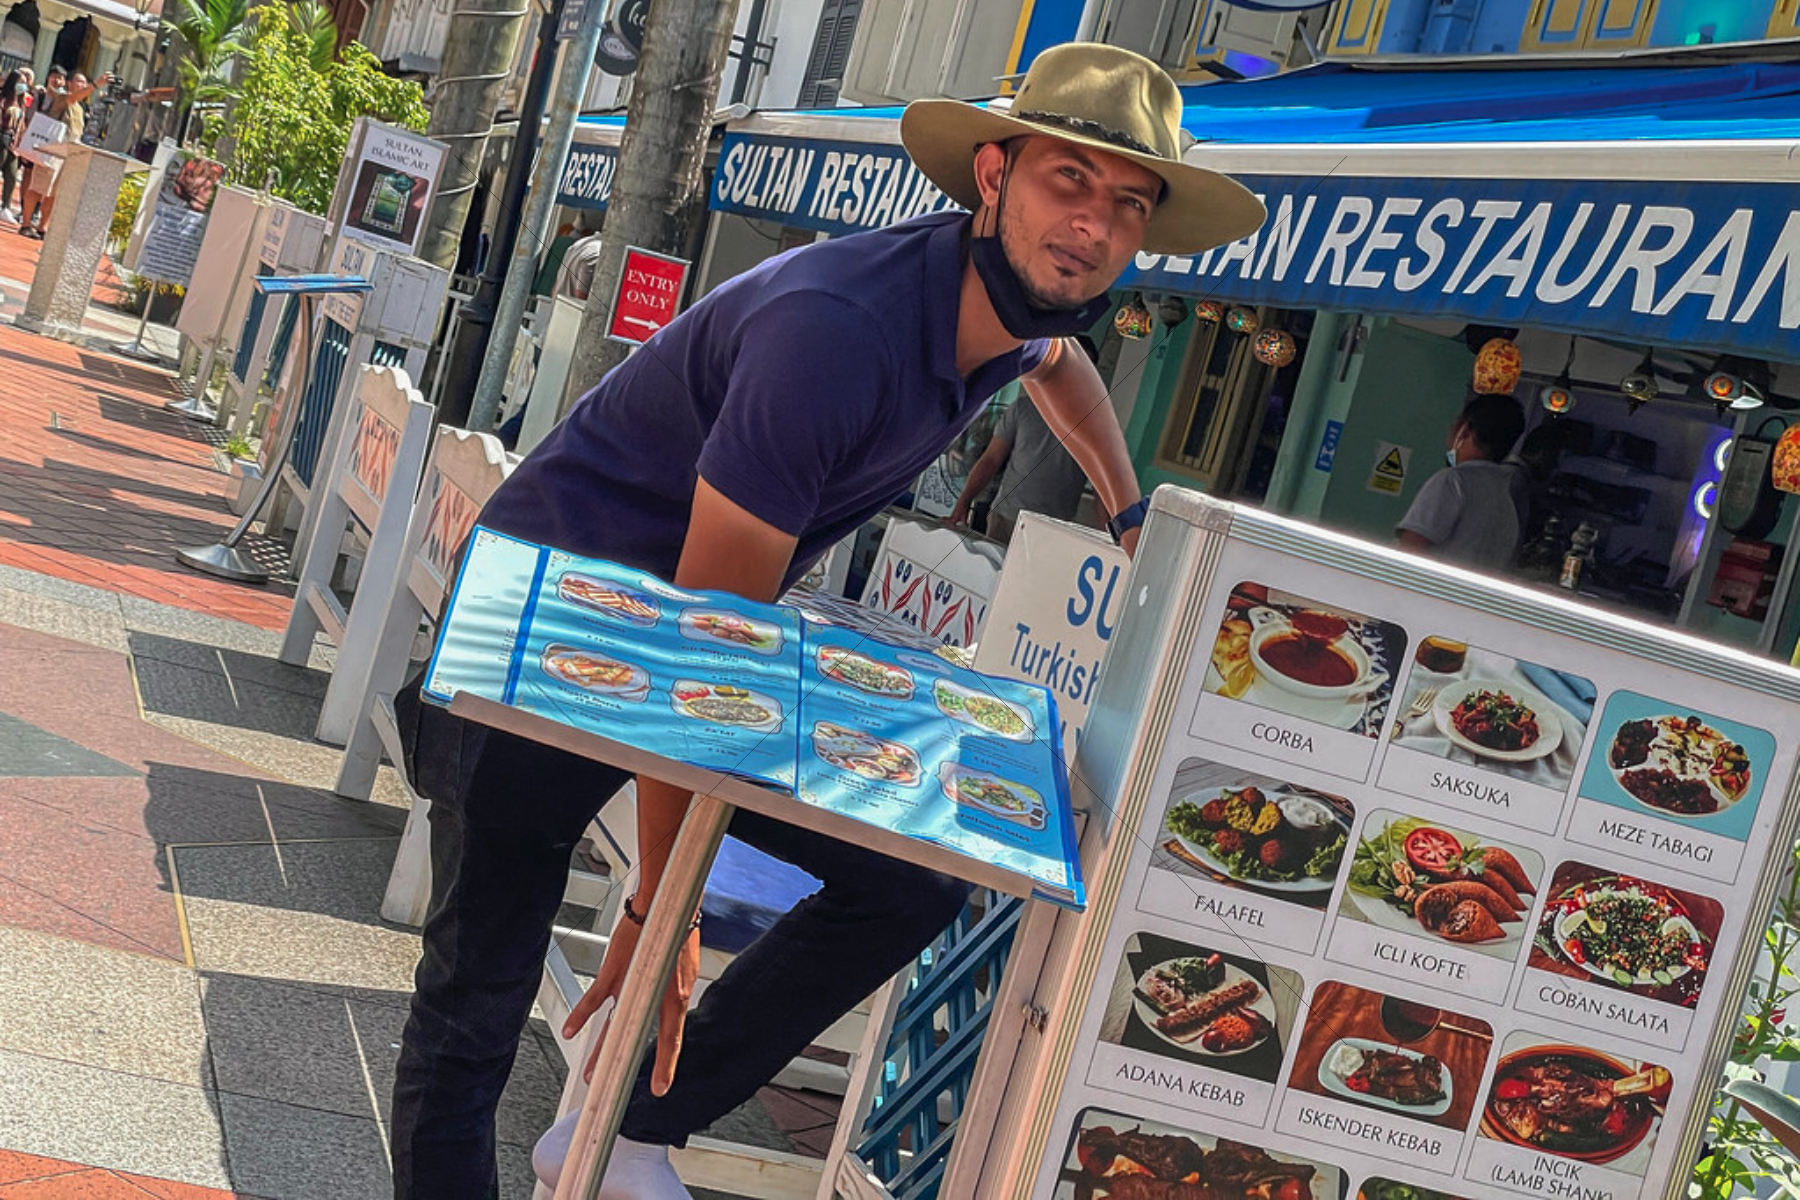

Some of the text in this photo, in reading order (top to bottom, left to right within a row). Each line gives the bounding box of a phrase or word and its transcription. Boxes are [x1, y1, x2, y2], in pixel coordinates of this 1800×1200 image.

[371, 146, 430, 171] ISLAMIC ART
[385, 138, 423, 157] SULTAN
[718, 142, 814, 213] SULTAN
[627, 269, 678, 292] ENTRY
[1304, 197, 1800, 329] RESTAURAN
[626, 289, 669, 310] ONLY
[1251, 722, 1314, 754] CORBA
[1430, 772, 1511, 808] SAKSUKA
[1599, 820, 1714, 864] MEZE TABAGI
[1194, 895, 1265, 929] FALAFEL
[1373, 942, 1468, 981] ICLI KOFTE
[1539, 986, 1669, 1034] COBAN SALATA
[1115, 1062, 1246, 1108] ADANA KEBAB
[1298, 1107, 1443, 1157] ISKENDER KEBAB
[1491, 1164, 1545, 1191] (LAMB
[1533, 1156, 1583, 1182] INCIK
